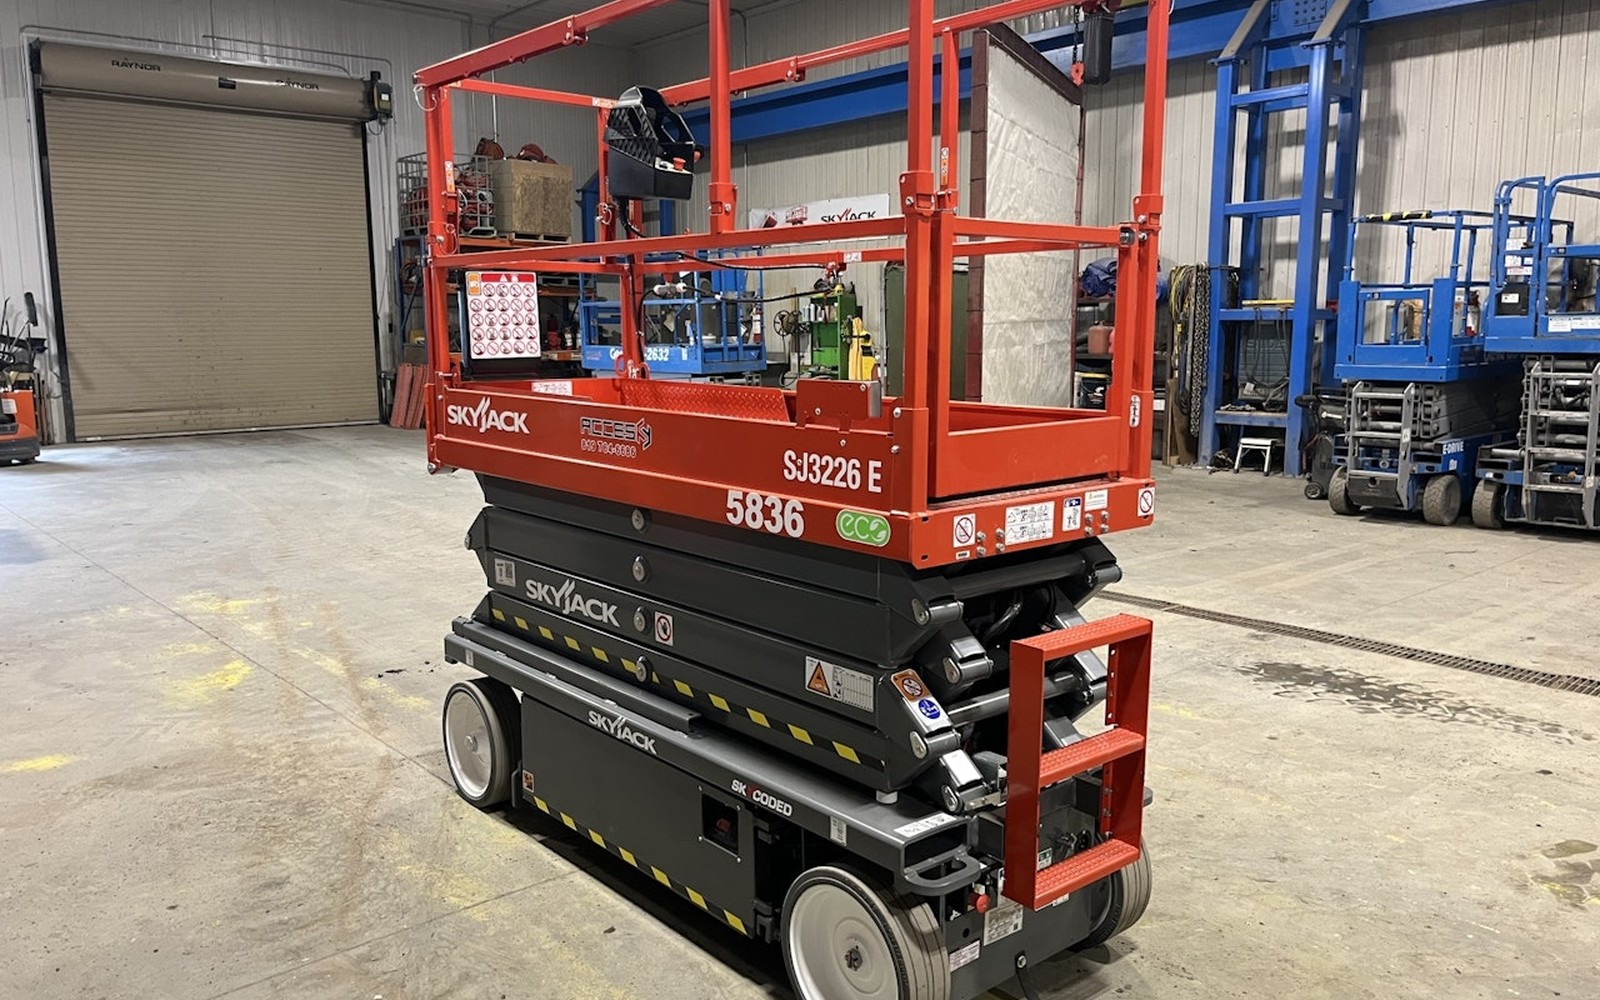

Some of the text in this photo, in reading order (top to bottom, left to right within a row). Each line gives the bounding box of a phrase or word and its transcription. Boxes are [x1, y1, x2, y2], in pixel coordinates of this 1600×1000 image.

[111, 58, 161, 72] RAYNOR
[447, 397, 530, 434] SKYJACK
[783, 450, 882, 493] SJ3226 E
[726, 489, 805, 538] 5836
[839, 513, 887, 542] eco
[525, 579, 620, 627] SKYJACK
[588, 710, 657, 754] SKYJACK
